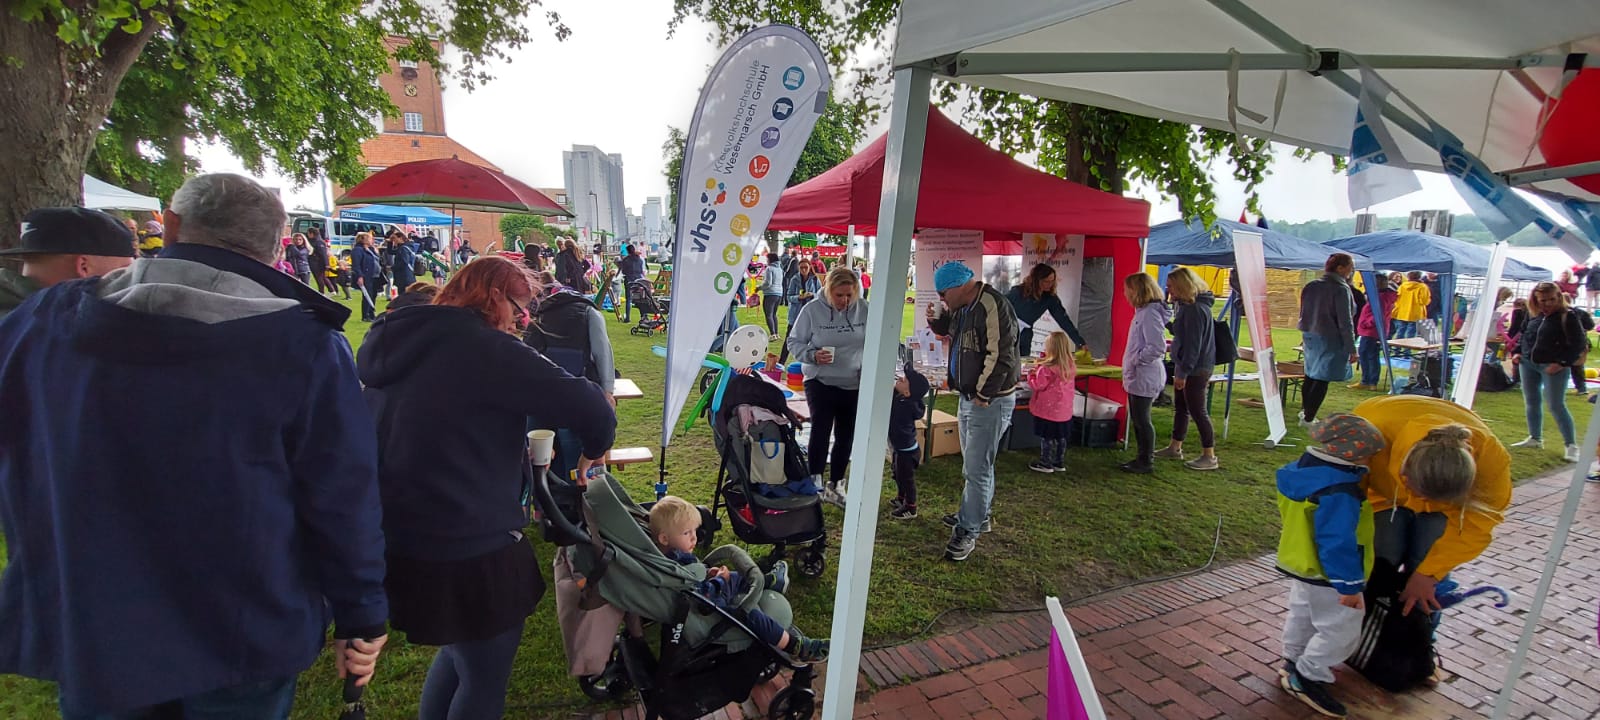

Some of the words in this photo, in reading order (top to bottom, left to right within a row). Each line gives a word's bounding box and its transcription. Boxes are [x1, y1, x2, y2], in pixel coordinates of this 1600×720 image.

[714, 59, 760, 173] Kreisvolkshochschule
[723, 103, 757, 175] Wesermarsch
[752, 64, 770, 100] GmbH
[341, 211, 361, 219] POLIZEI
[690, 208, 717, 253] vhs
[670, 623, 684, 645] Joie
